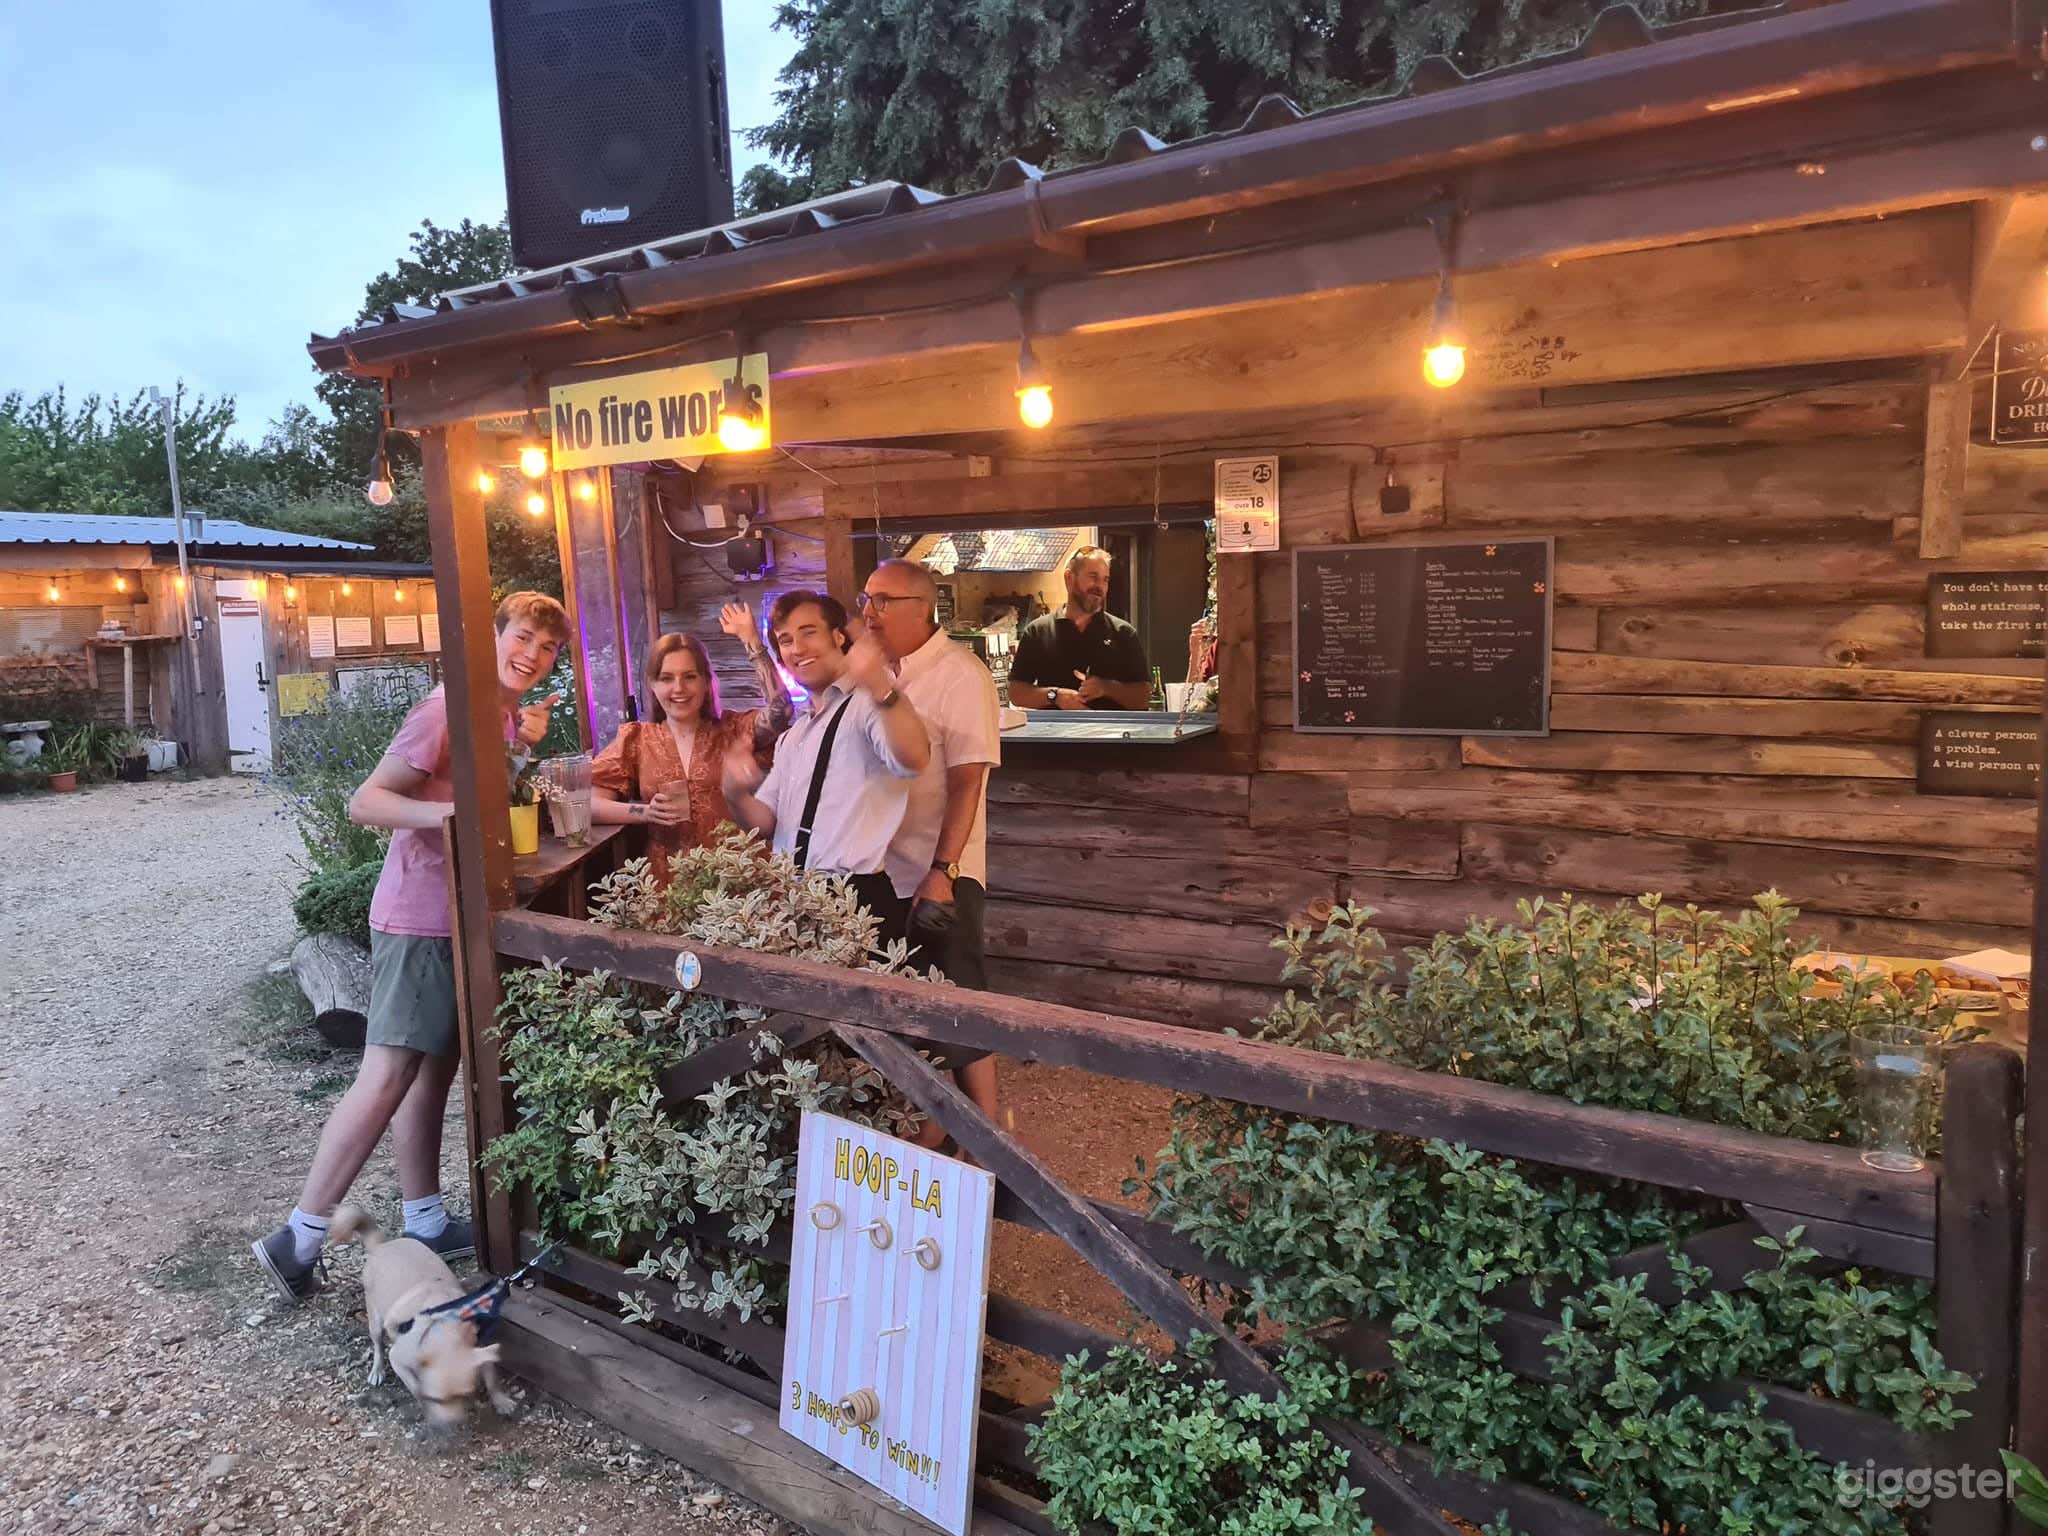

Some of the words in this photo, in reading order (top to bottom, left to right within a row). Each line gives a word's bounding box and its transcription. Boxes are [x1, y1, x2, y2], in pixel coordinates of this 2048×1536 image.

[2009, 403, 2048, 418] DRI
[555, 402, 593, 451] No
[599, 395, 653, 447] fire
[1255, 466, 1270, 480] 25
[1250, 496, 1264, 508] 18
[1943, 583, 1964, 592] You
[1969, 582, 1999, 592] don't
[2004, 583, 2033, 592] have
[1942, 602, 1976, 611] whole
[1980, 602, 2045, 612] staircase,
[1941, 621, 1968, 630] take
[1972, 621, 1993, 630] the
[1996, 621, 2031, 630] first
[1935, 729, 1943, 738] A
[1948, 729, 1990, 738] clever
[1995, 731, 2037, 740] person
[1946, 745, 2001, 754] problem.
[1933, 759, 1940, 768] A
[1946, 760, 1974, 768] wise
[1979, 761, 2022, 770] person
[835, 1137, 942, 1218] HOOP-LA
[792, 1381, 801, 1410] 3
